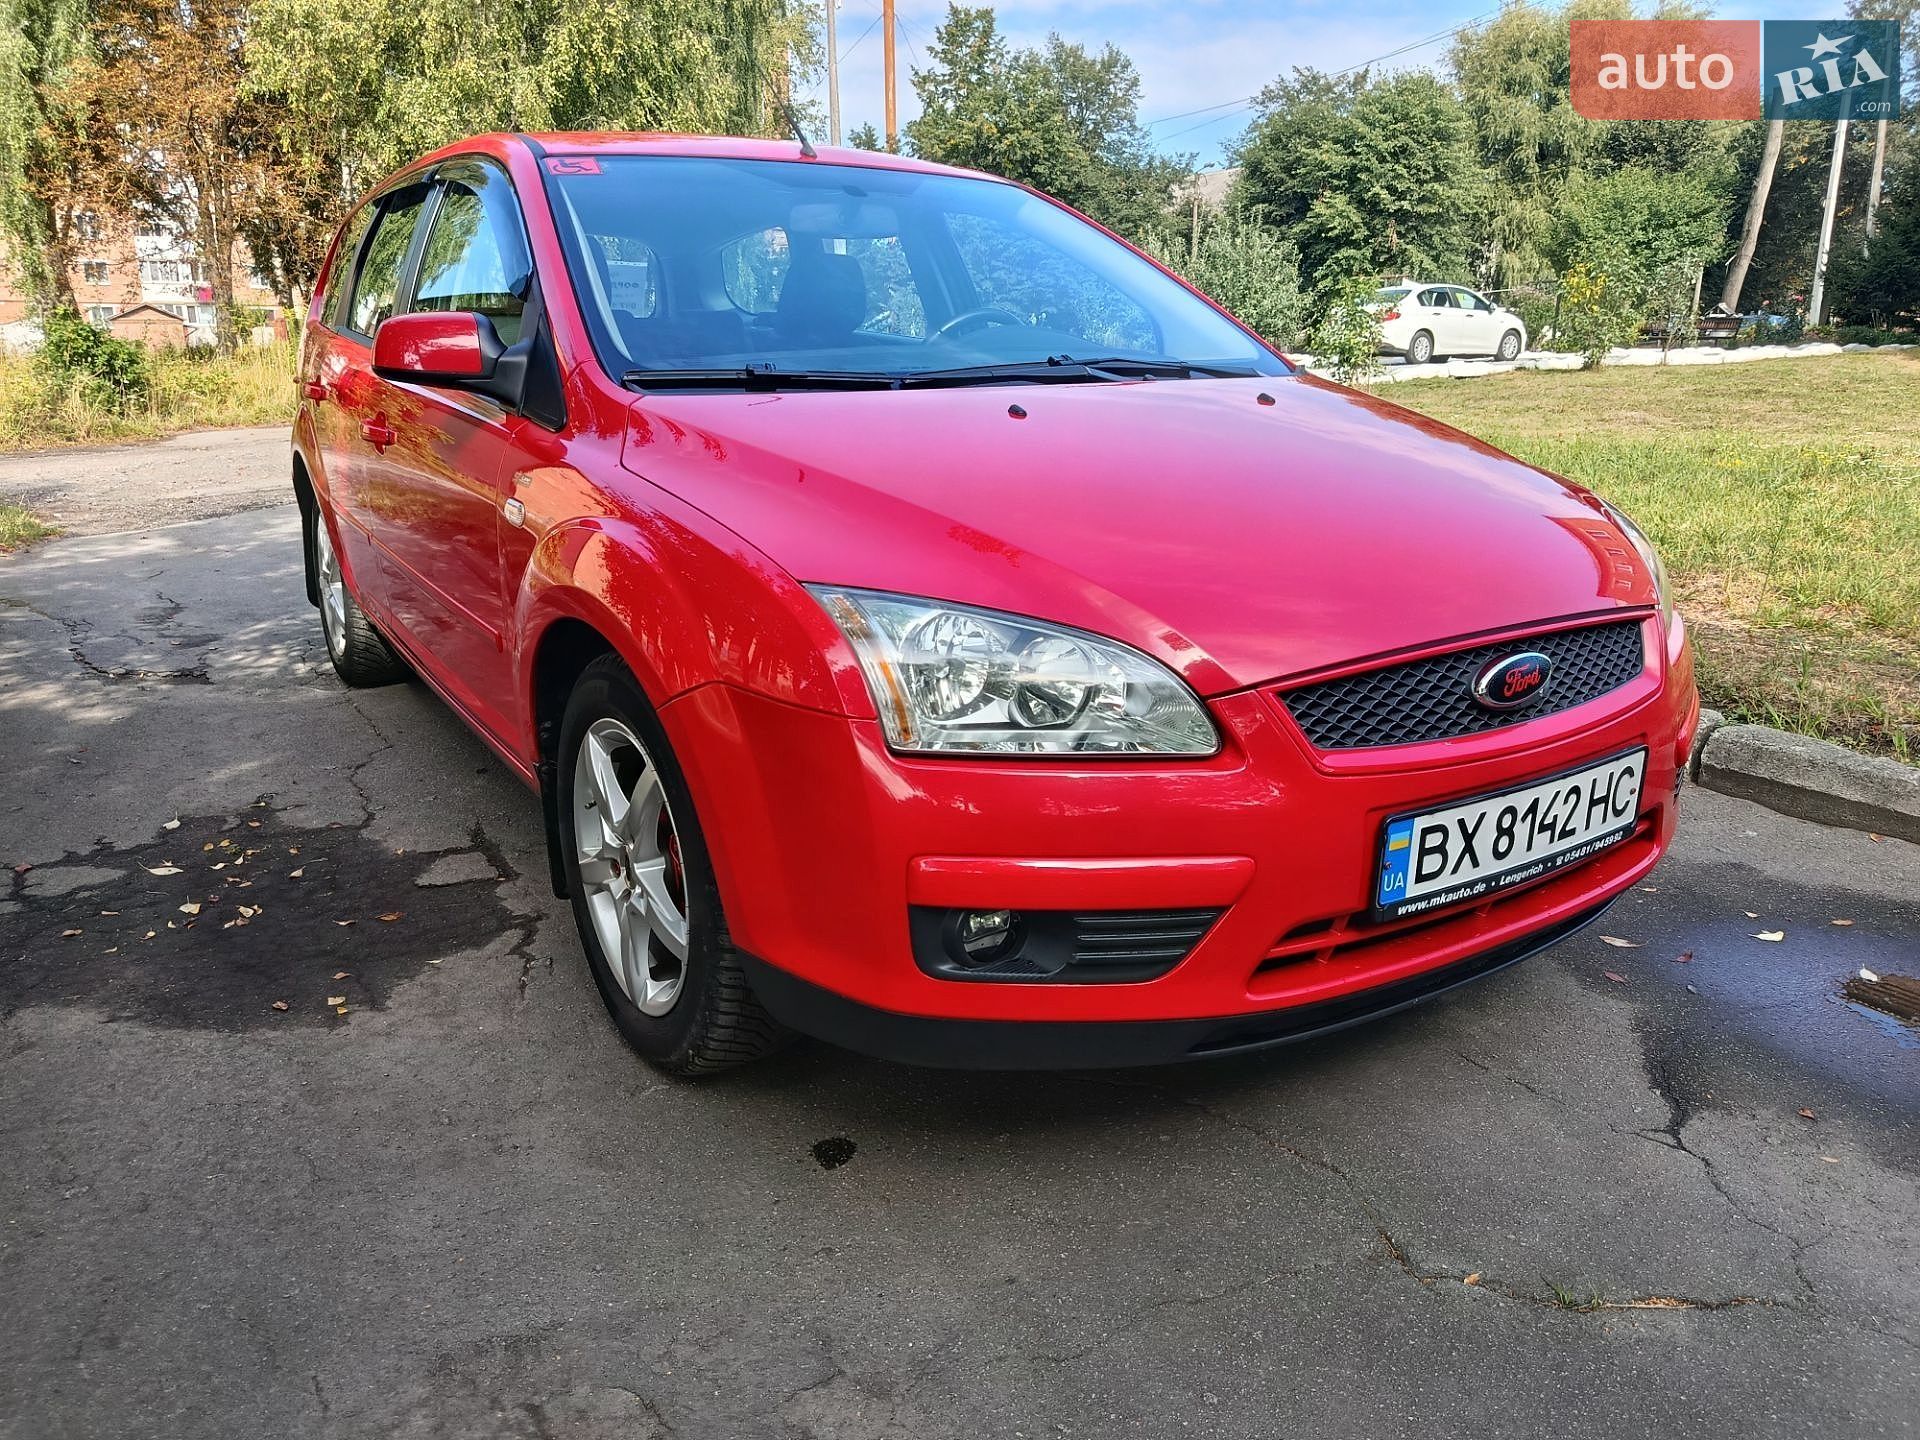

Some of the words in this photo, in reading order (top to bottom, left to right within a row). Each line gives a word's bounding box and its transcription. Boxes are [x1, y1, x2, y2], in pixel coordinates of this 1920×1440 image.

[1504, 664, 1541, 697] Ford
[1414, 811, 1487, 885] BX
[1491, 784, 1582, 862] 8142
[1584, 765, 1635, 832] HC
[1383, 871, 1404, 892] UA
[1397, 882, 1486, 916] www.mkauto.de
[1499, 863, 1544, 887] Lengerich
